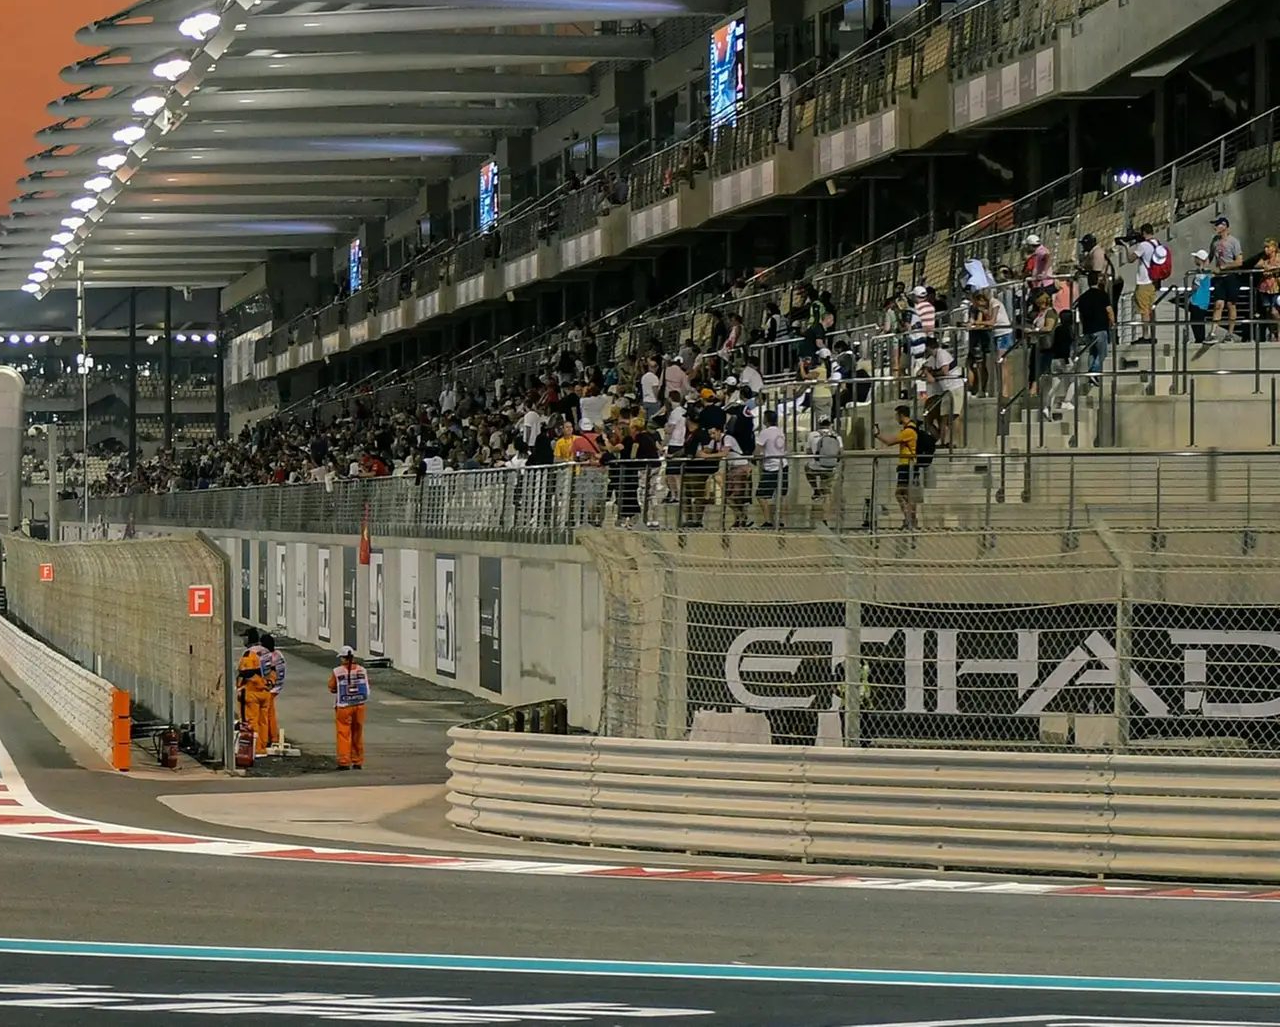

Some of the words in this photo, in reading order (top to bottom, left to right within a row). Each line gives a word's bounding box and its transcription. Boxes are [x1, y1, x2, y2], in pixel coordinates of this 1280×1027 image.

[43, 566, 50, 577] F
[194, 590, 206, 612] F
[725, 626, 1280, 719] ETIHAD
